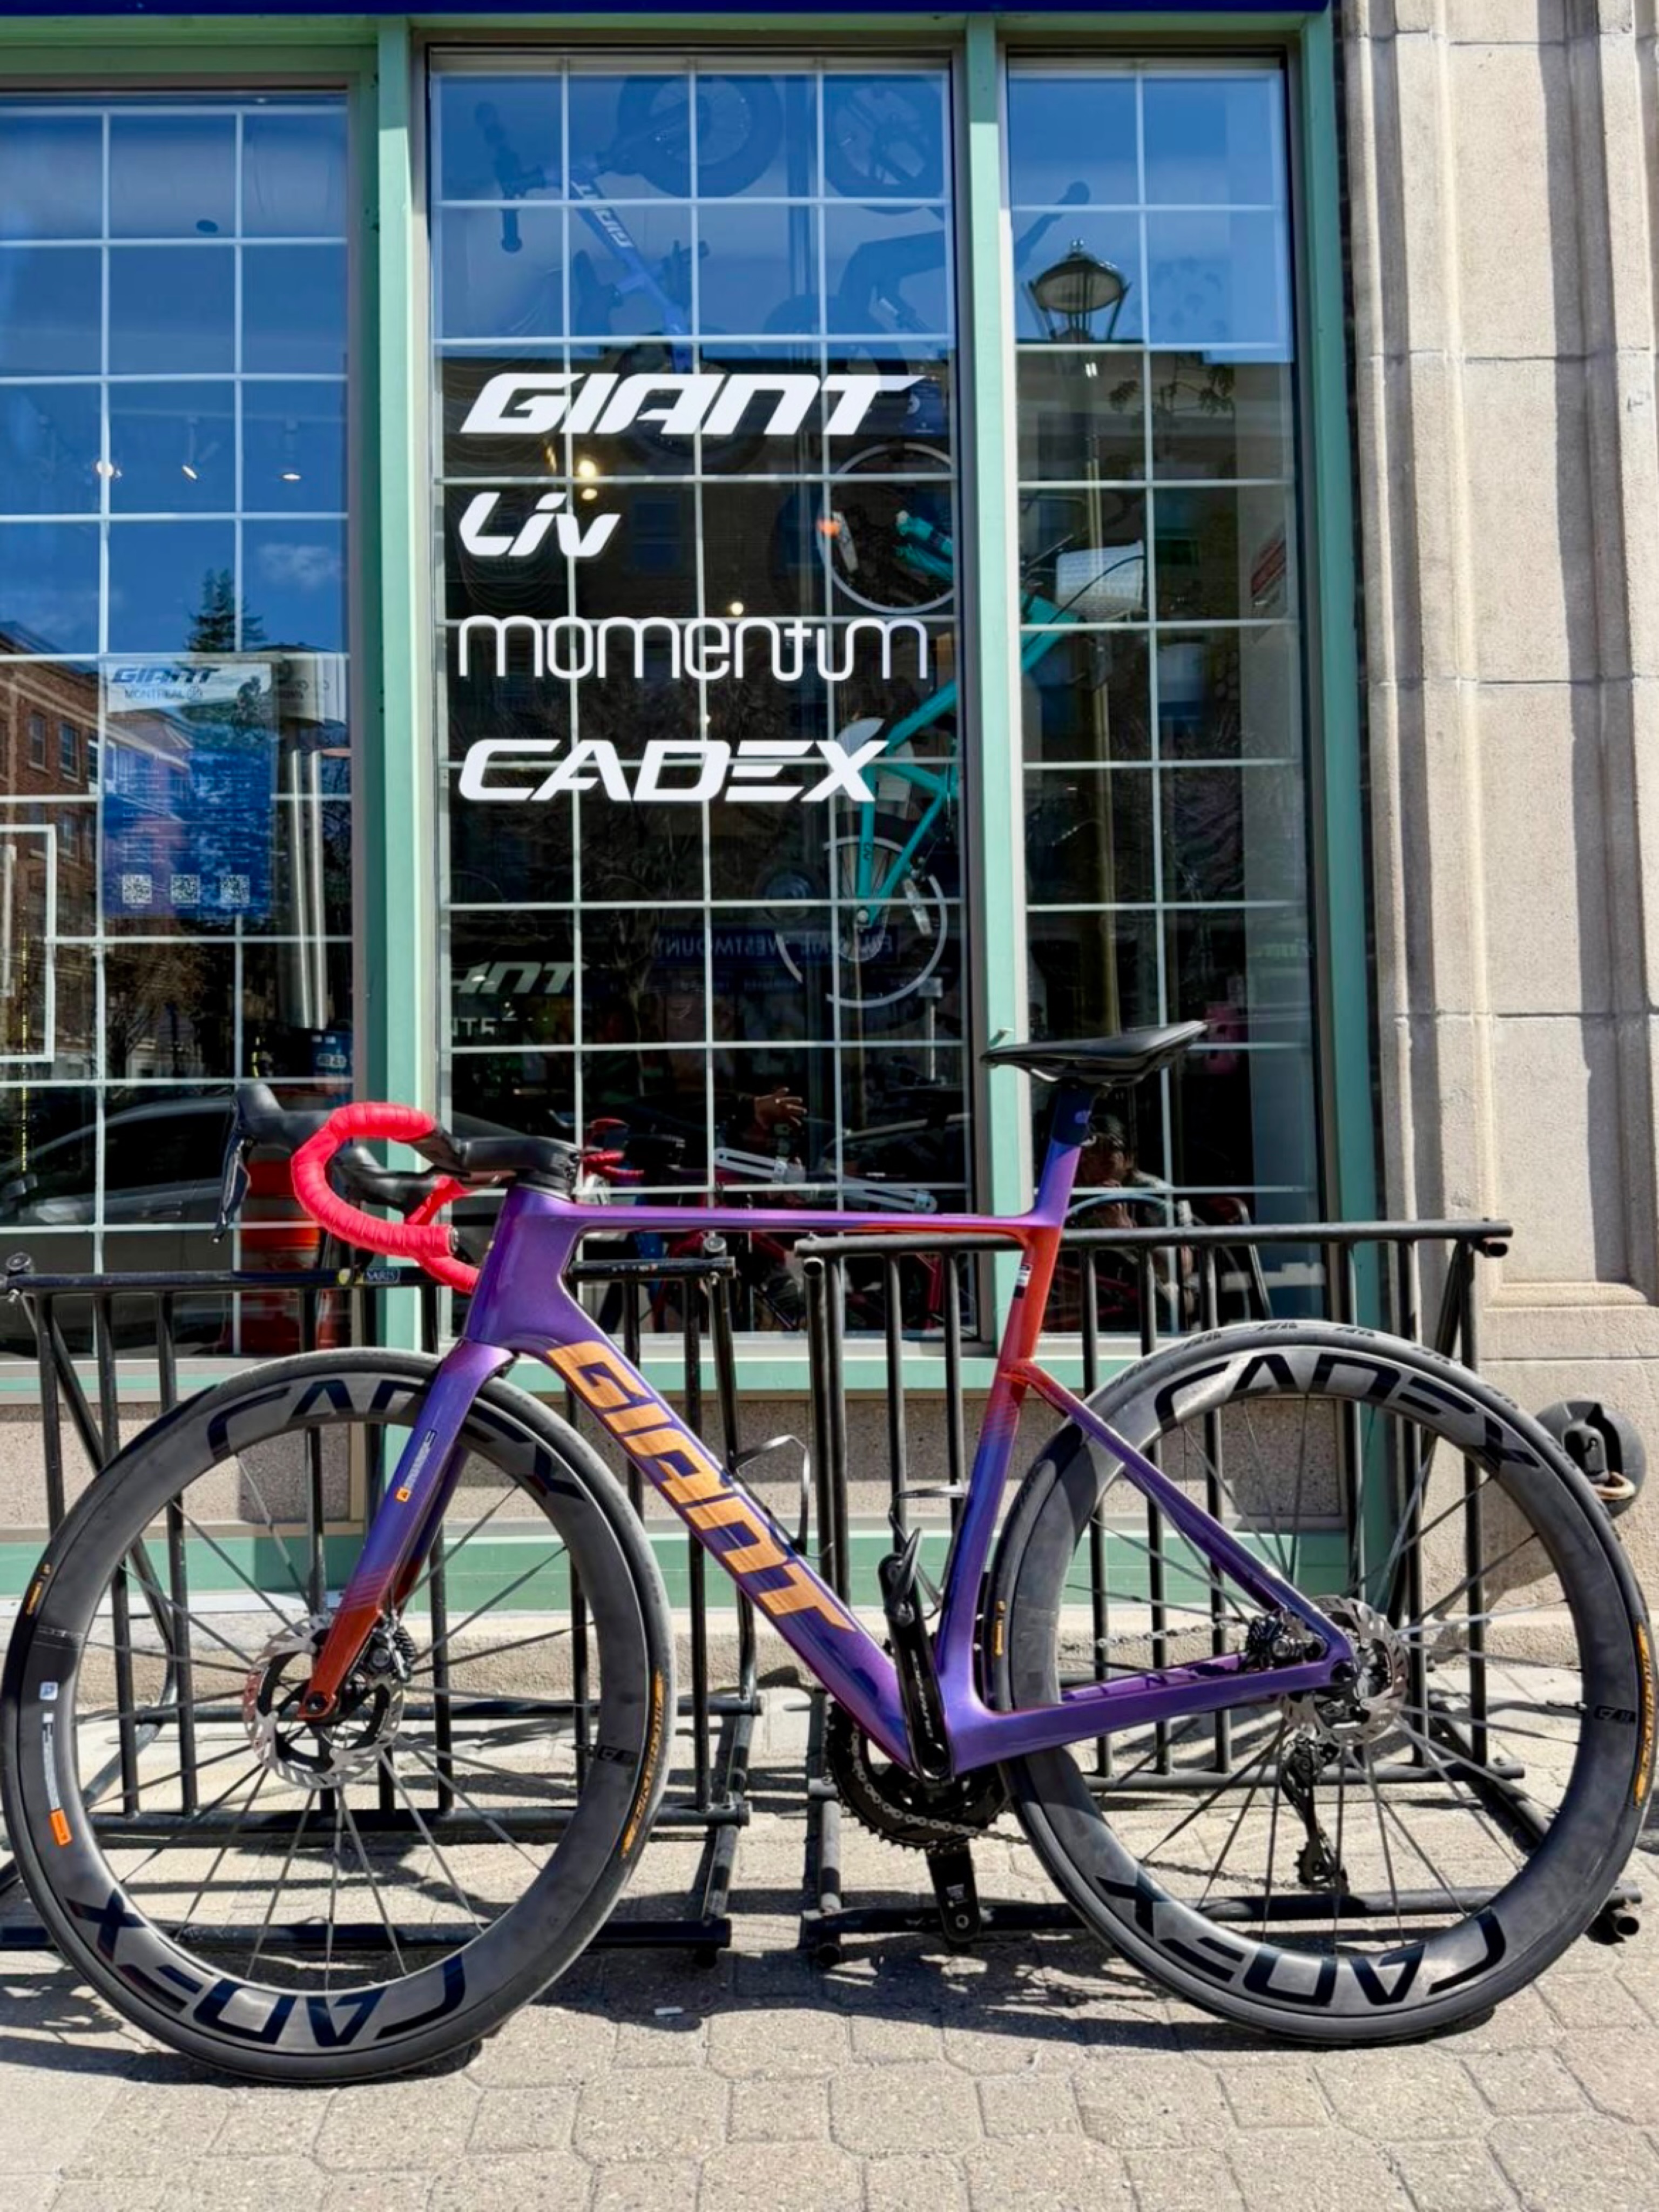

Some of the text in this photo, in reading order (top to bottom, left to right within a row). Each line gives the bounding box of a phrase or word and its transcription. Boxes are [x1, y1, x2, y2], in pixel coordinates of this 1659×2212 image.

[460, 373, 927, 435] GIANT
[460, 492, 621, 557] Liv
[112, 667, 220, 683] GIANT
[459, 615, 927, 681] momentum
[459, 739, 889, 802] CADEX
[1154, 1353, 1540, 1475] CADEX
[547, 1341, 857, 1631] GIANT
[65, 1888, 467, 2047] CADEX
[1094, 1867, 1506, 2006] CADEX
